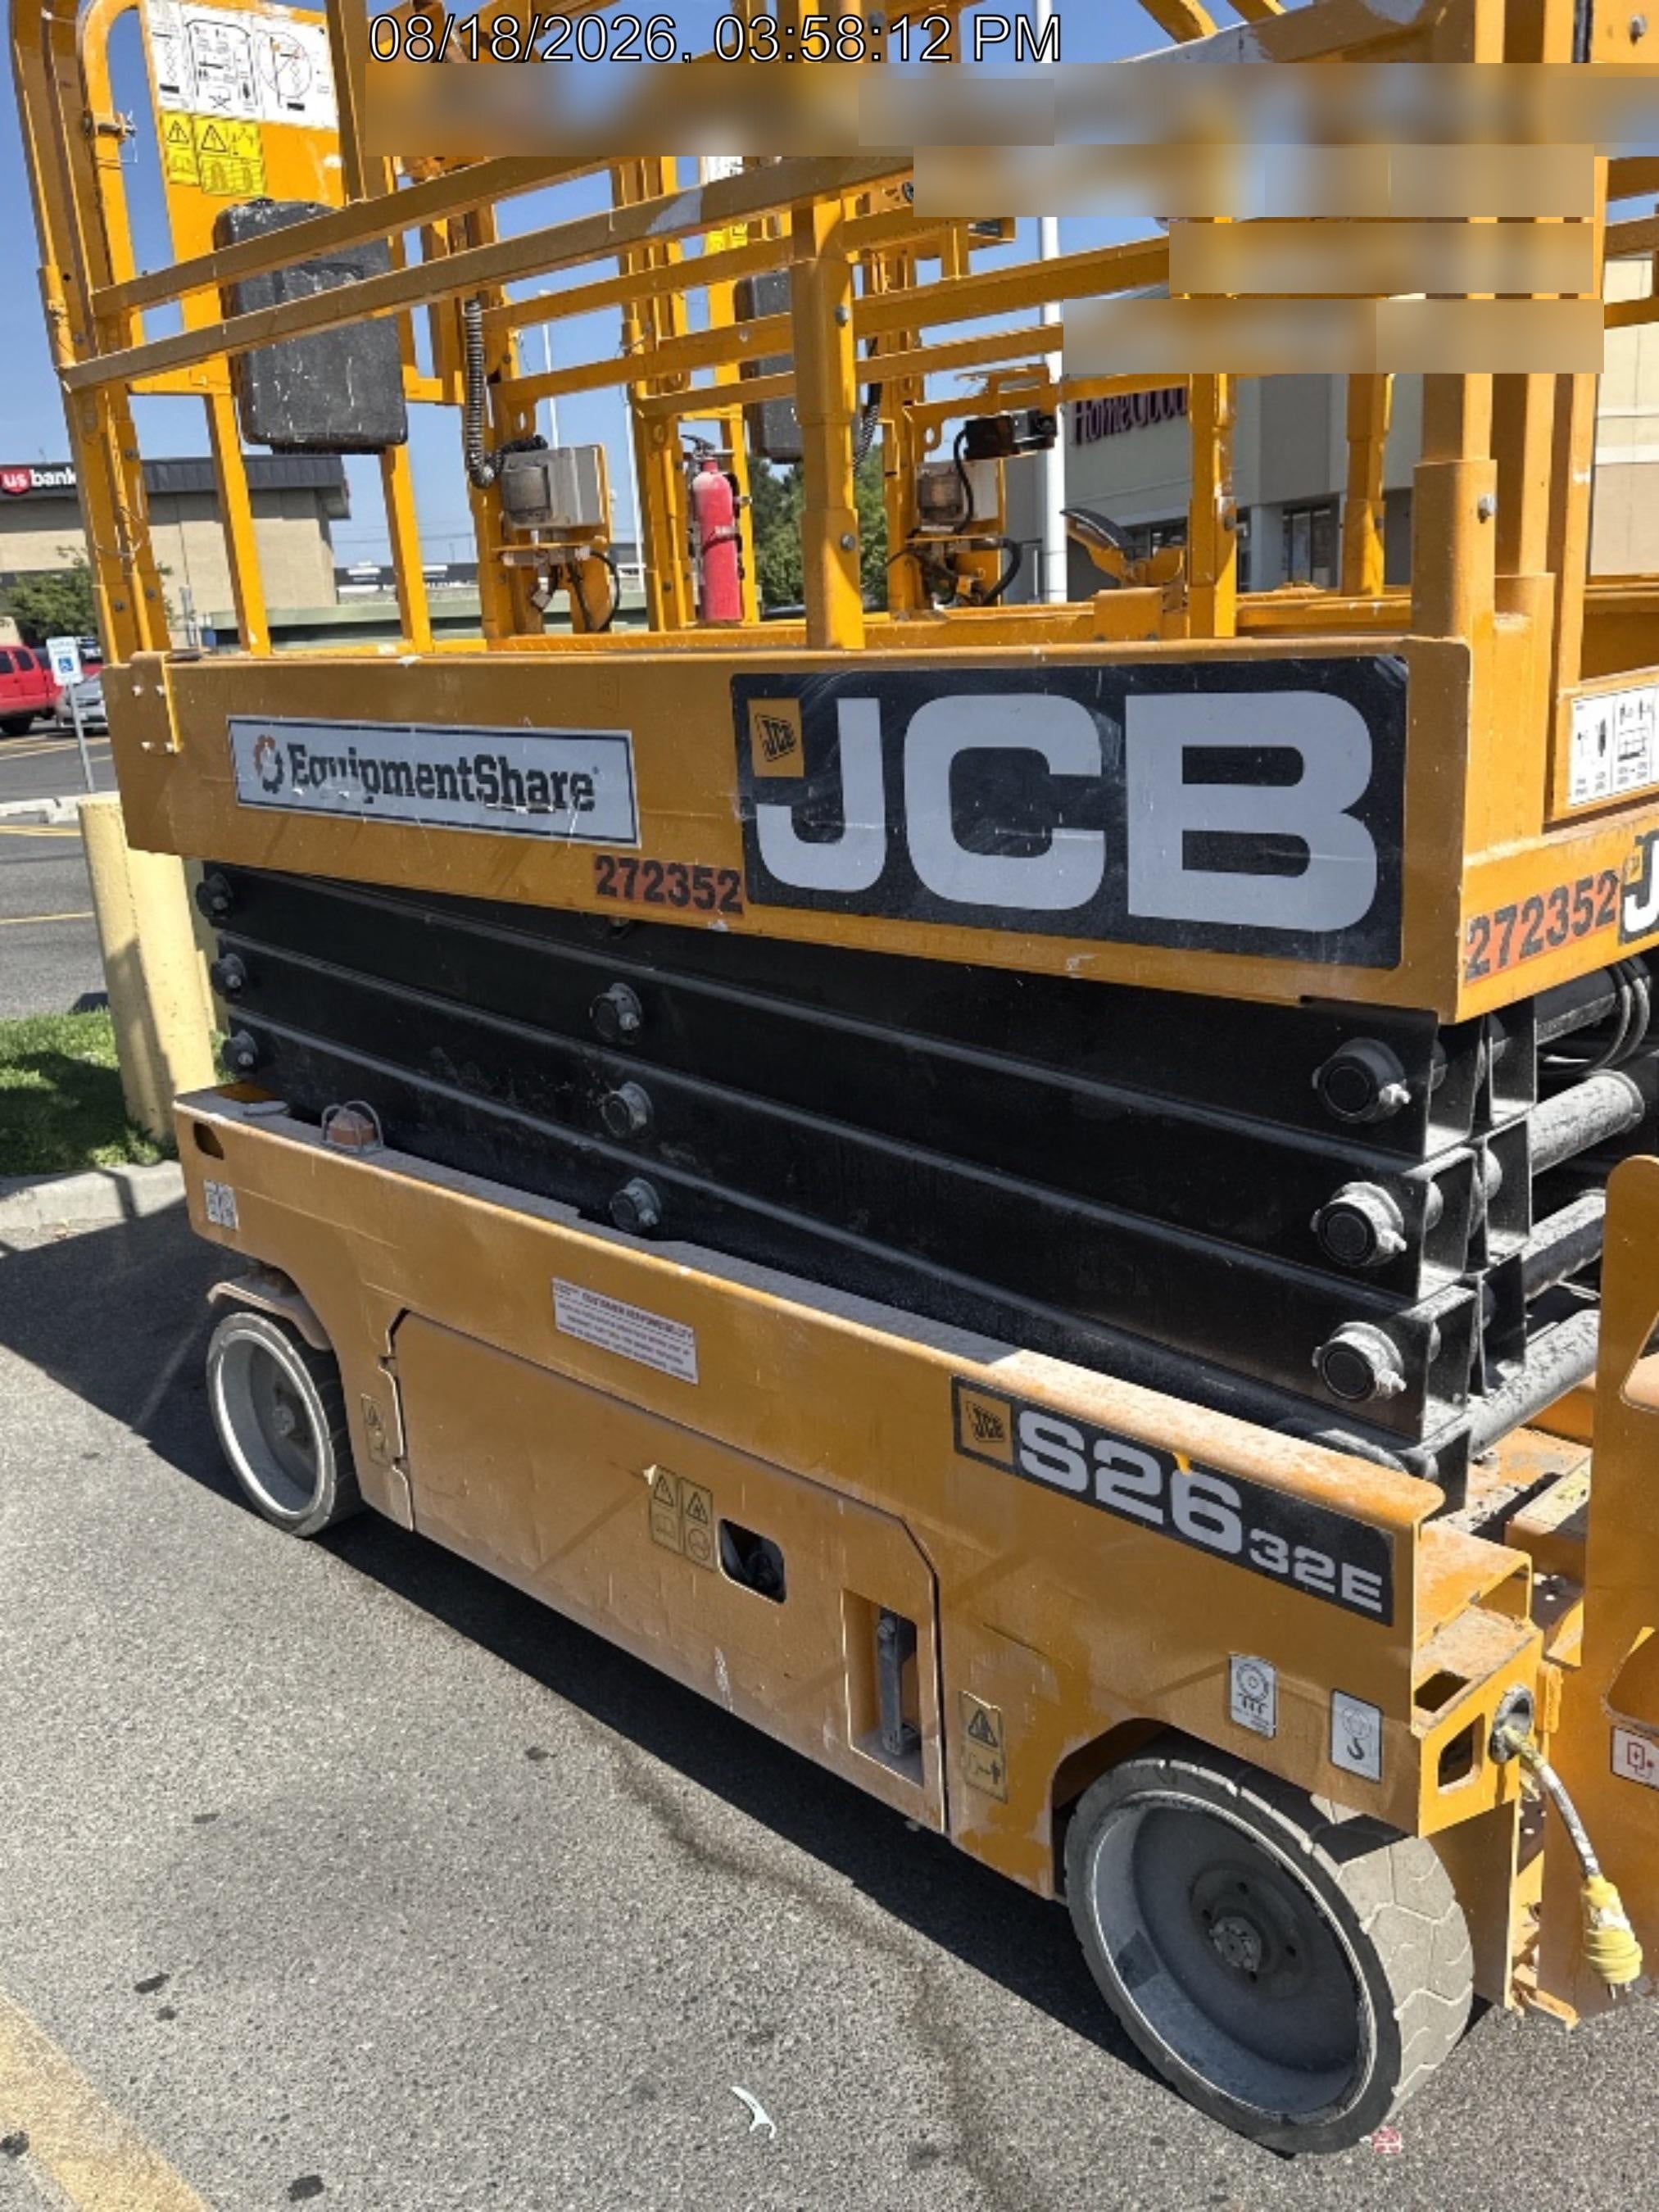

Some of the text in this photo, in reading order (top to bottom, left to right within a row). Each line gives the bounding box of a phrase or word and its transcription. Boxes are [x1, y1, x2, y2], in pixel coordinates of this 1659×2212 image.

[288, 742, 596, 811] EquipmentShare
[755, 690, 1377, 931] JCB
[594, 854, 743, 913] 272352
[1465, 869, 1619, 980] 272352
